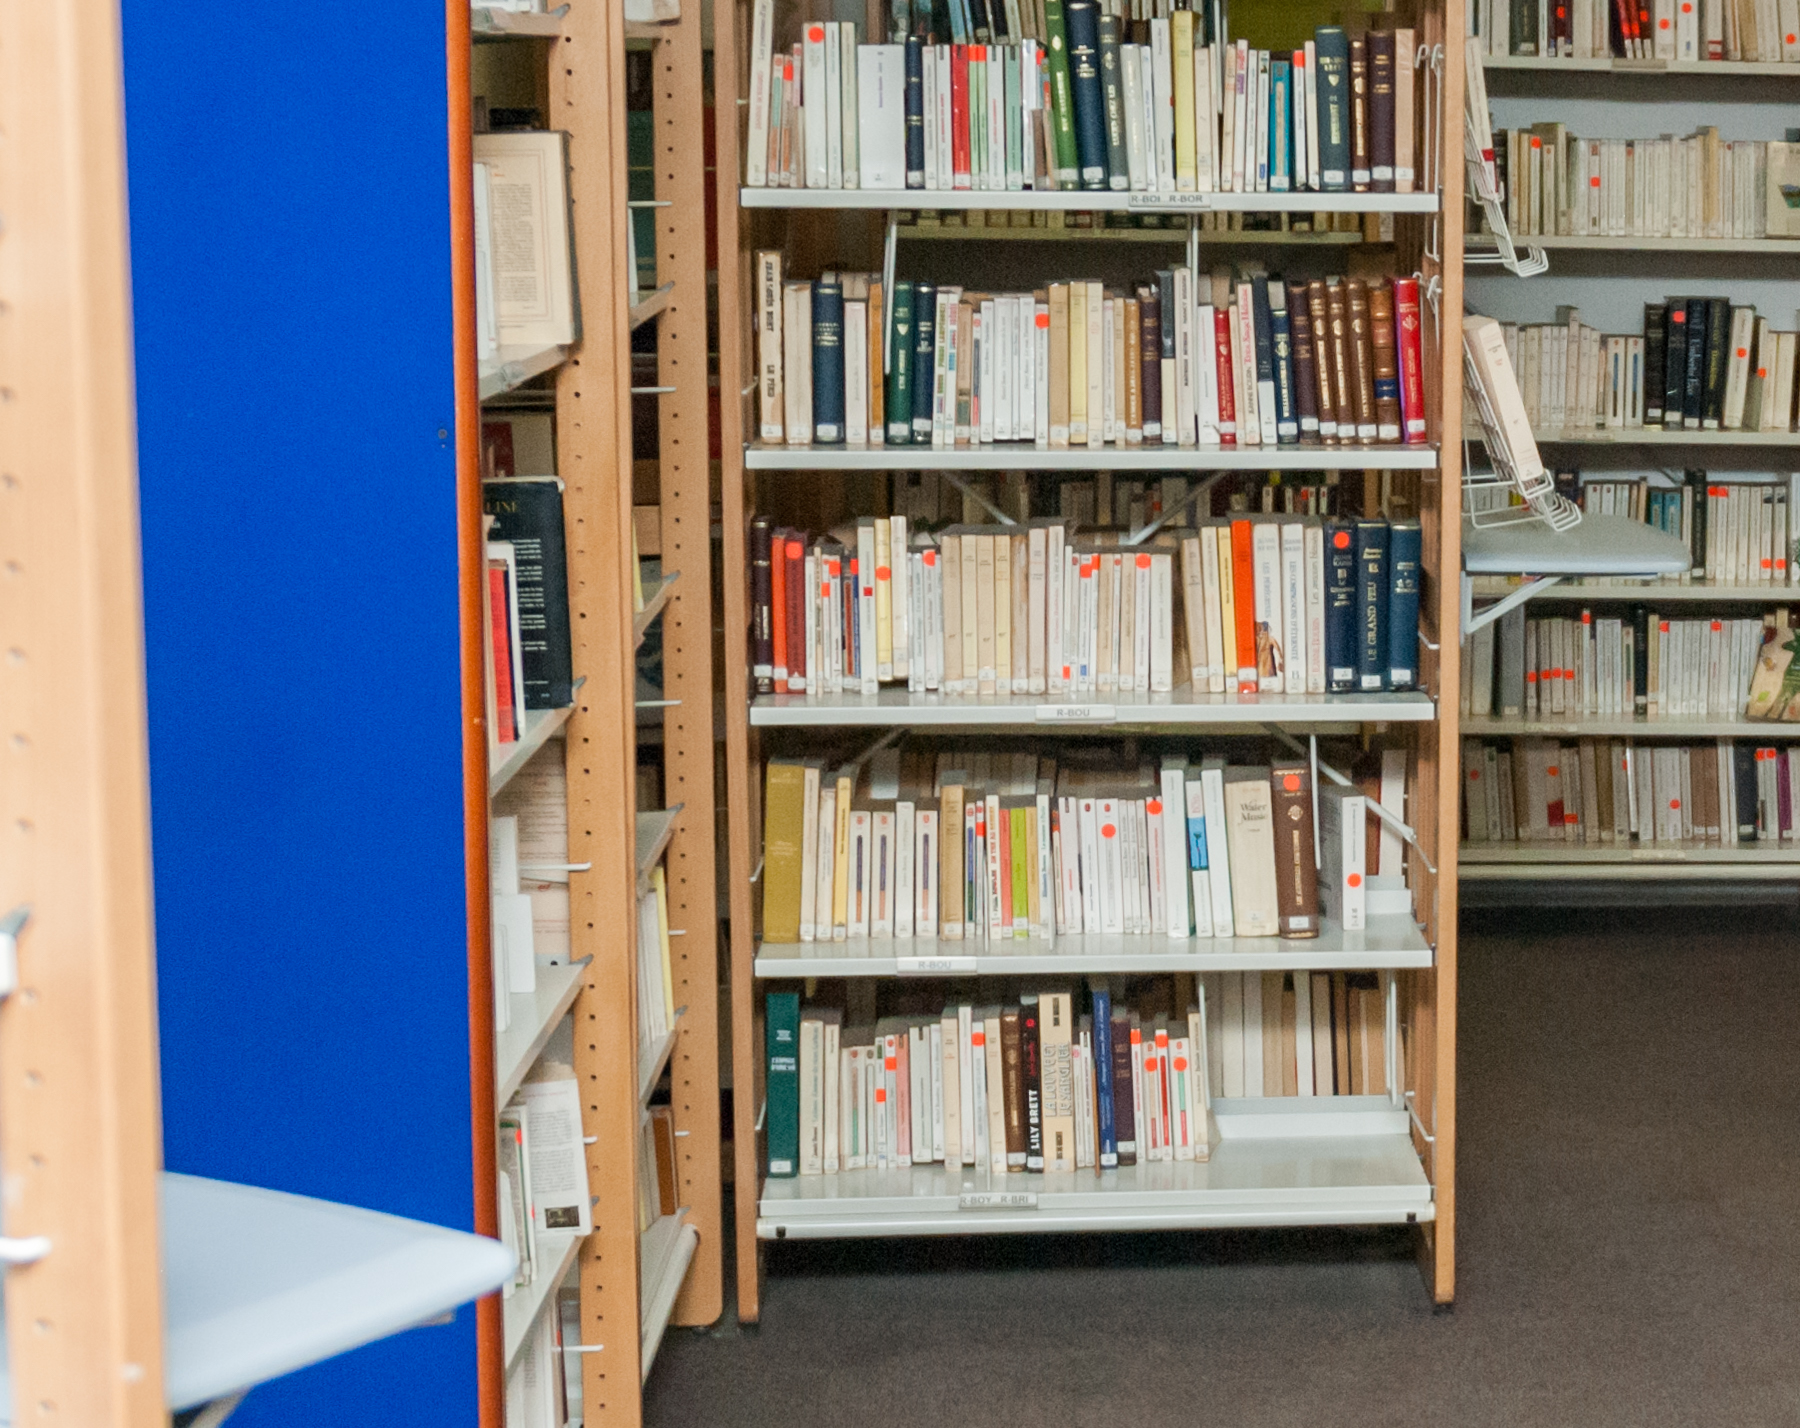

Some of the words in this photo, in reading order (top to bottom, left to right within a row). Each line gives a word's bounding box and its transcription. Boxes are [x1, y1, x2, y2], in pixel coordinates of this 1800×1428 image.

[1131, 194, 1161, 203] R-BOI
[1169, 194, 1203, 203] R-BOR
[1308, 530, 1319, 559] blessées
[1366, 581, 1377, 602] FEU
[1366, 605, 1377, 645] GRAND
[1366, 648, 1377, 661] LE
[1056, 708, 1090, 717] R-BOU
[918, 960, 952, 969] R-BOU
[1059, 1042, 1073, 1101] SANGLIER
[1028, 1089, 1040, 1124] BRETT
[1029, 1126, 1040, 1150] LILY
[961, 1195, 992, 1204] R-BOY
[1001, 1195, 1029, 1204] R-BRI
